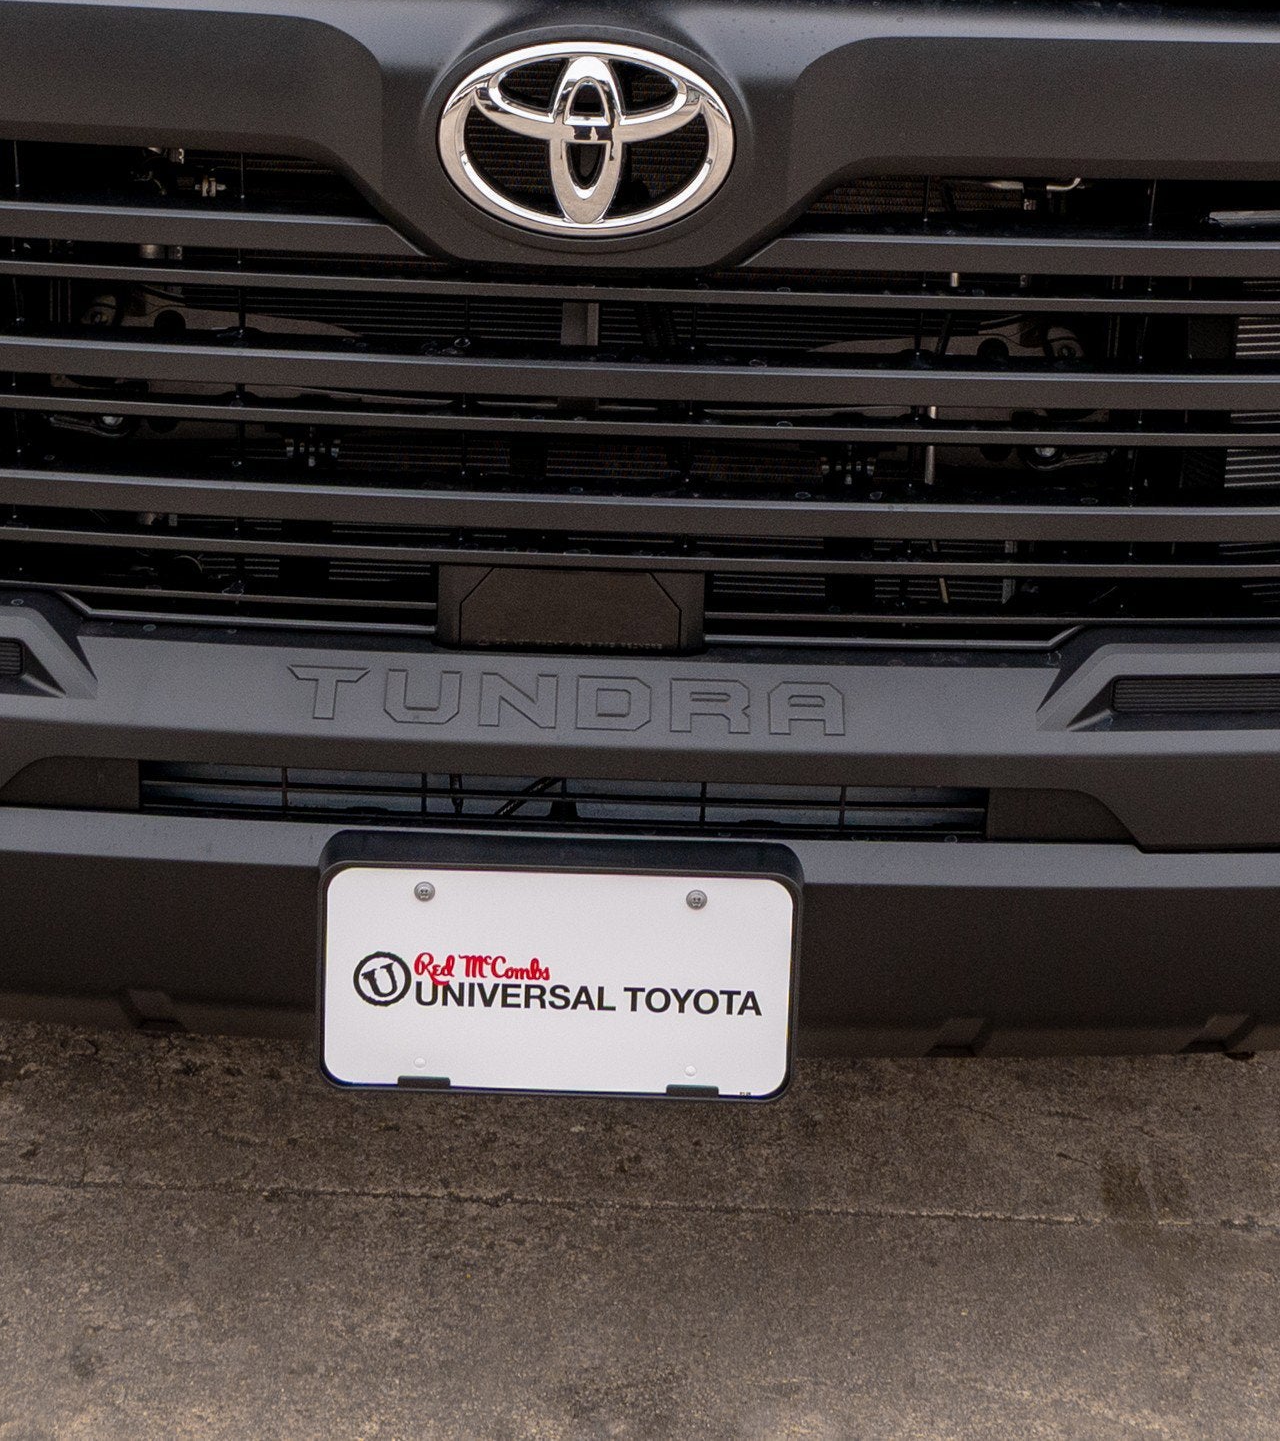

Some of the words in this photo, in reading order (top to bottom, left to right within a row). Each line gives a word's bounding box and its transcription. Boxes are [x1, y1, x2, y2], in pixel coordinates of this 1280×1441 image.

[287, 664, 846, 736] TUNDRA
[414, 952, 455, 986] Red
[459, 954, 550, 981] McCombs
[415, 980, 617, 1012] UNIVERSAL
[623, 986, 763, 1017] TOYOTA
